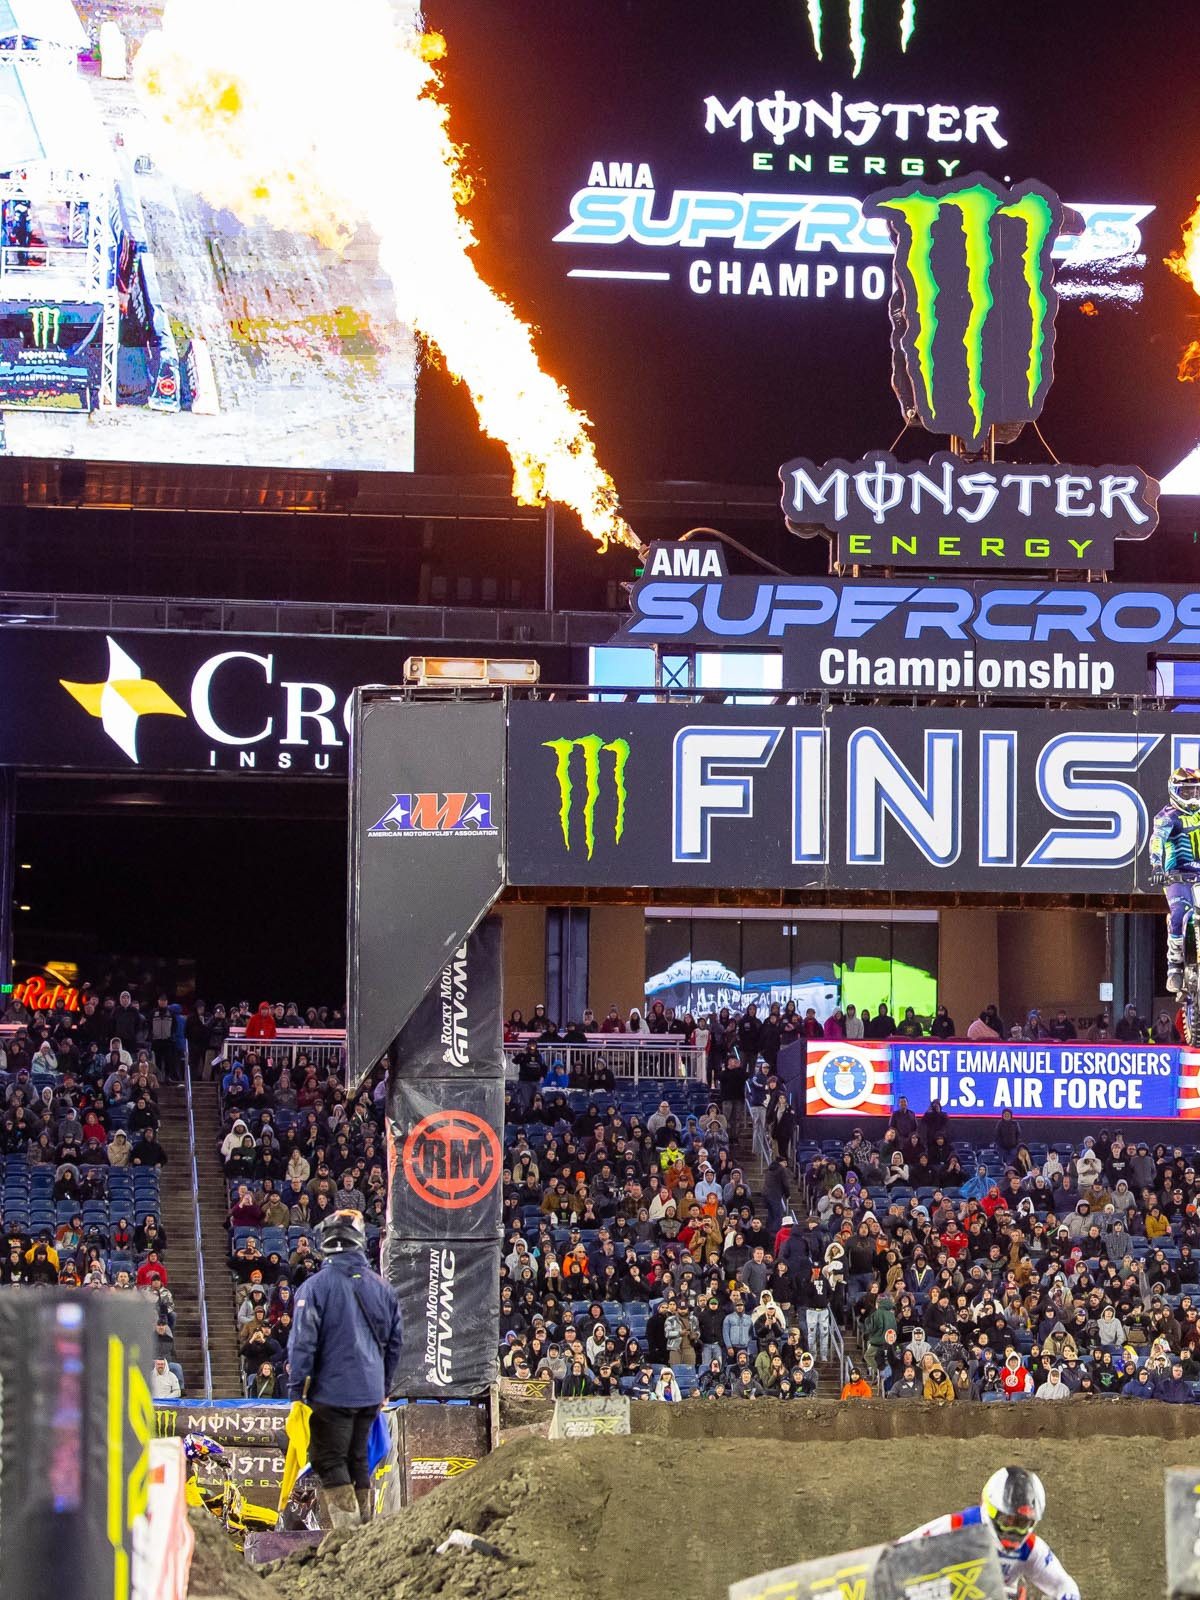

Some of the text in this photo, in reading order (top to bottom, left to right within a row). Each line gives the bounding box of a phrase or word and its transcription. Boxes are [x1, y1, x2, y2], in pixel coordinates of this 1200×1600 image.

[704, 90, 1008, 149] MONSTER
[587, 161, 655, 188] AMA
[752, 152, 960, 177] ENERGY
[689, 260, 898, 301] CHAMPIO
[790, 461, 1150, 524] MONSTER
[651, 548, 723, 577] AMA
[849, 535, 1093, 559] ENERGY
[819, 648, 1115, 695] Championship
[209, 750, 331, 770] INSU
[366, 793, 499, 831] AMA
[441, 1001, 453, 1046] ROCKY
[899, 1049, 1172, 1076] MSGT EMMANUEL DESROSIERS
[929, 1077, 1143, 1110] U.S. AIR FORCE
[425, 1247, 441, 1365] ROCKY MOUNTAIN
[188, 1413, 287, 1433] MONSTE
